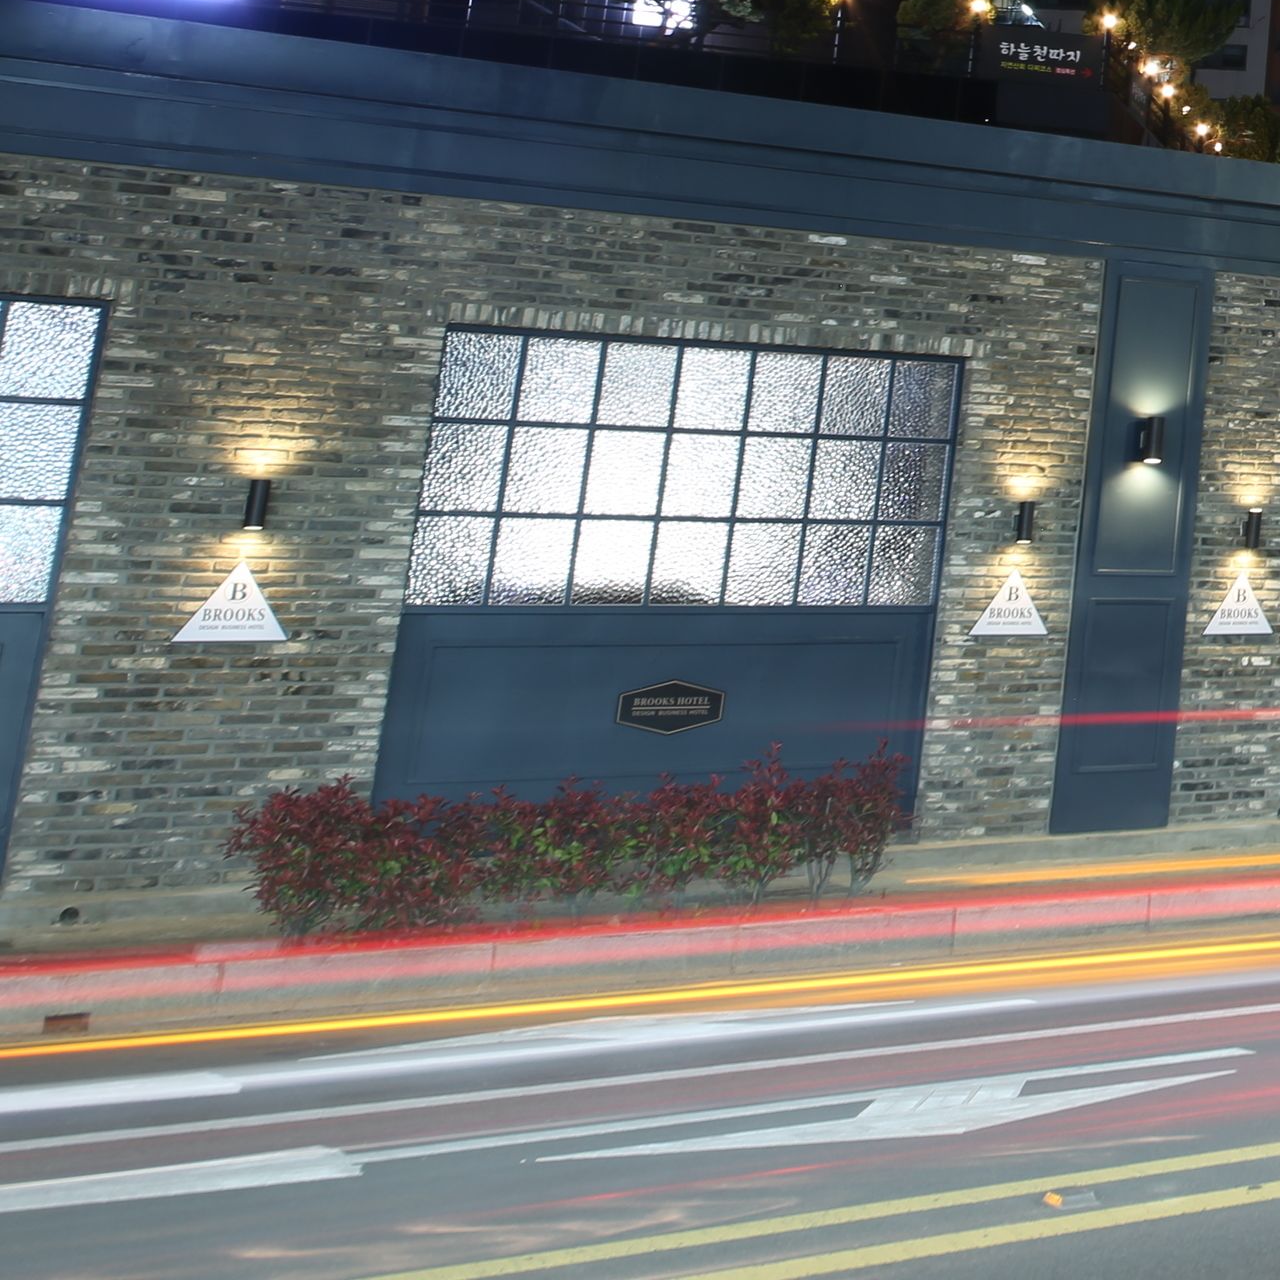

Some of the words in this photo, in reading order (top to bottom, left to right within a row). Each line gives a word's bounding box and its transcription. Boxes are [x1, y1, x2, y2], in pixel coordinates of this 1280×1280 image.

[1000, 41, 1081, 63] 하늘천따지
[201, 608, 267, 622] BROOKS
[989, 607, 1033, 619] BROOKS
[1220, 607, 1259, 620] BROOKS
[633, 697, 676, 707] BROOKS
[676, 696, 711, 706] HOTEL
